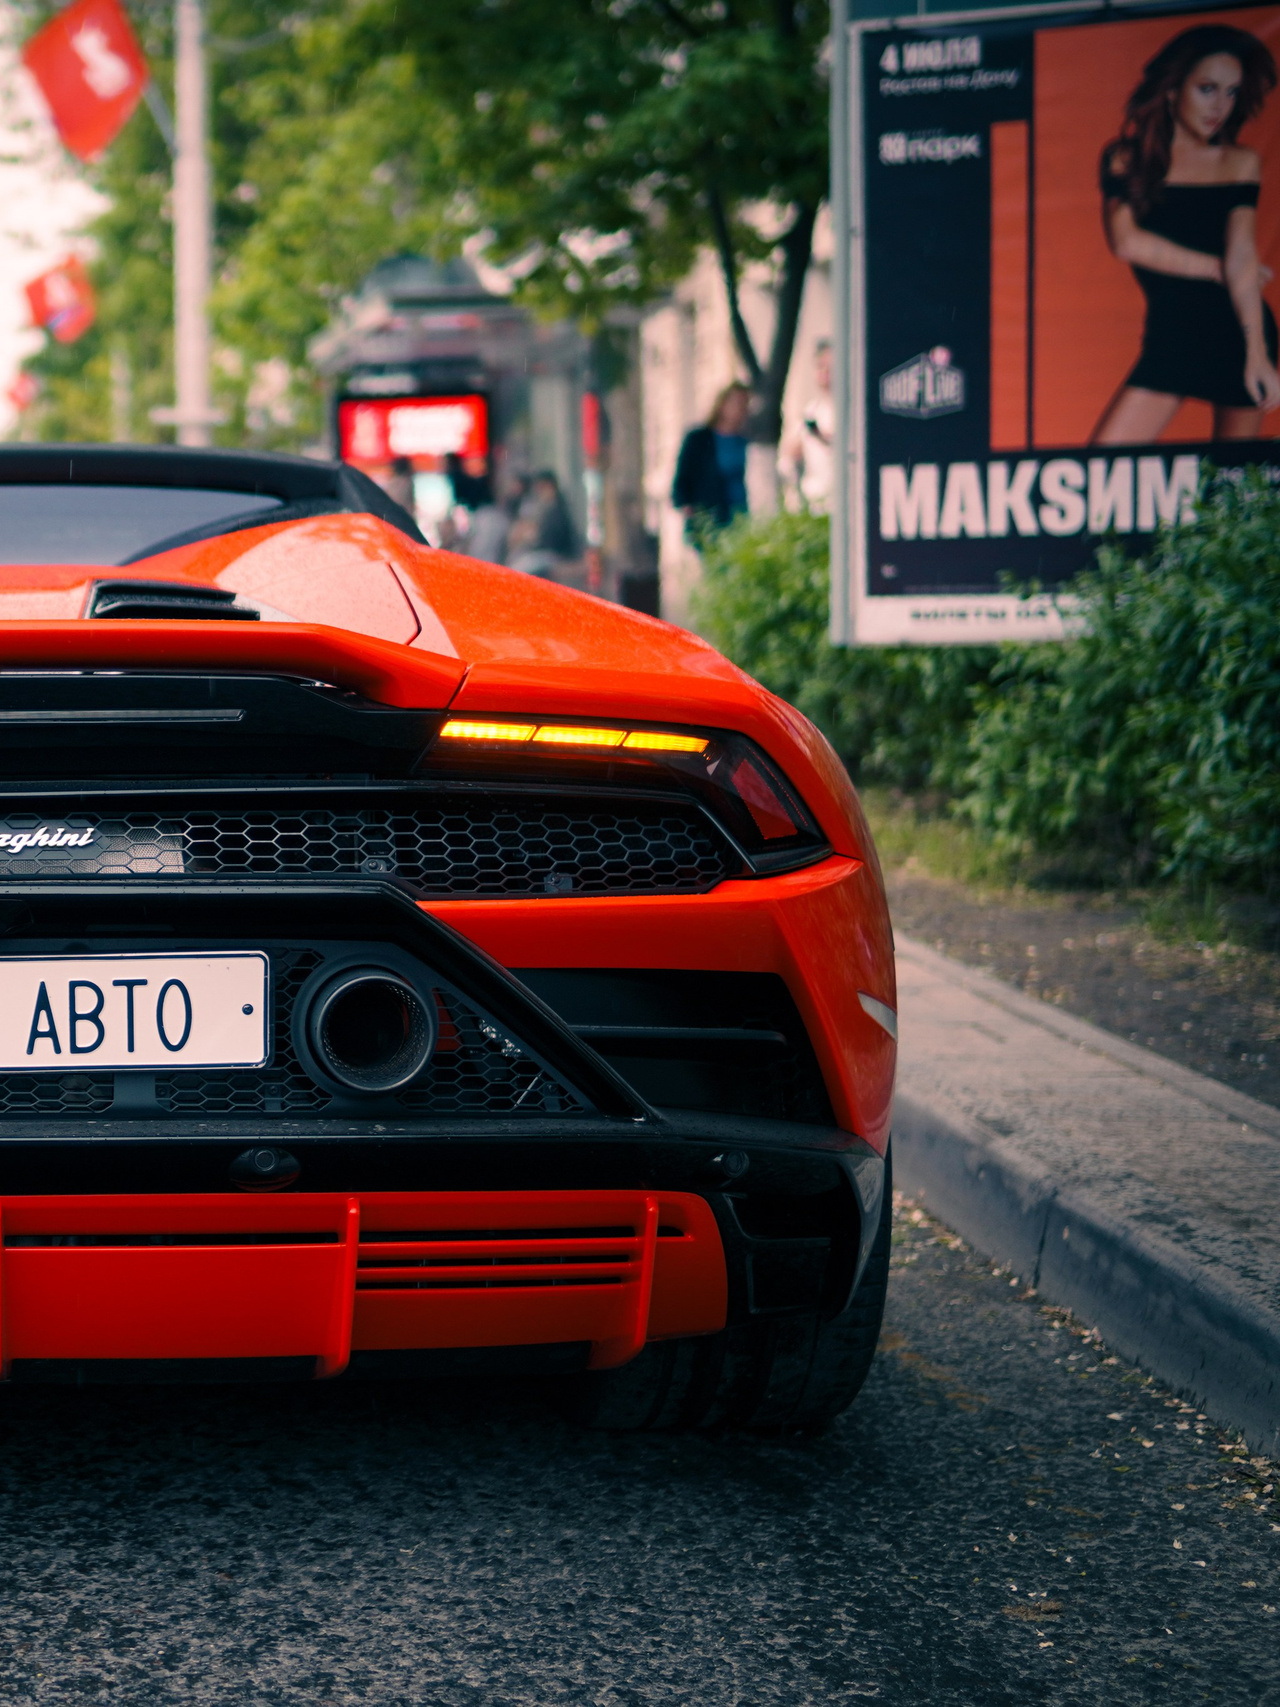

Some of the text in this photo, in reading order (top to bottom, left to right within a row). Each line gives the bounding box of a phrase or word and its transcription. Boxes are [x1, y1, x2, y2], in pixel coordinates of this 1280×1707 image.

[879, 34, 981, 74] 4 ИЮЛЯ
[908, 133, 981, 164] парк
[26, 978, 193, 1055] АВТО
